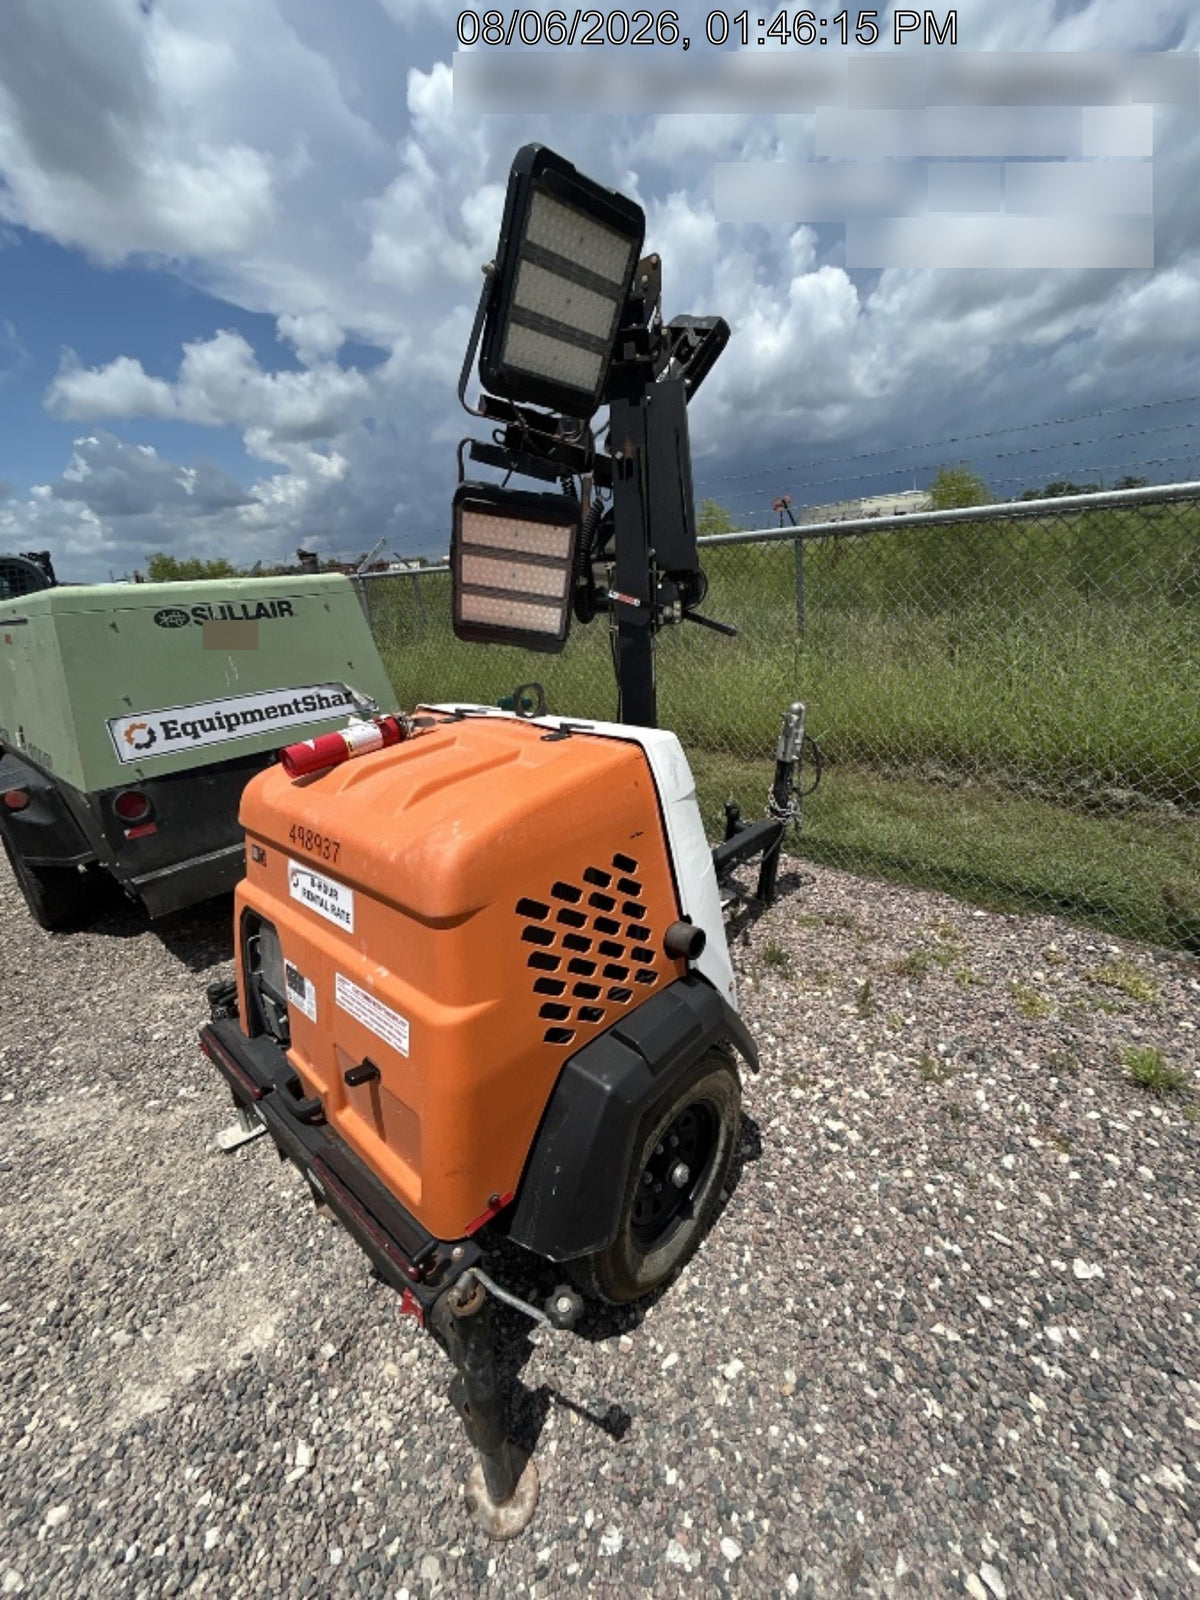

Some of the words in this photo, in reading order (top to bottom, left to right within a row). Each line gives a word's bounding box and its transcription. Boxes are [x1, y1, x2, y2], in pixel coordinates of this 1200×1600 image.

[190, 600, 294, 626] SULLAIR
[159, 691, 354, 740] EquipmentShar
[289, 823, 340, 864] 498937
[302, 887, 329, 912] RENTAL
[330, 903, 351, 925] RATE
